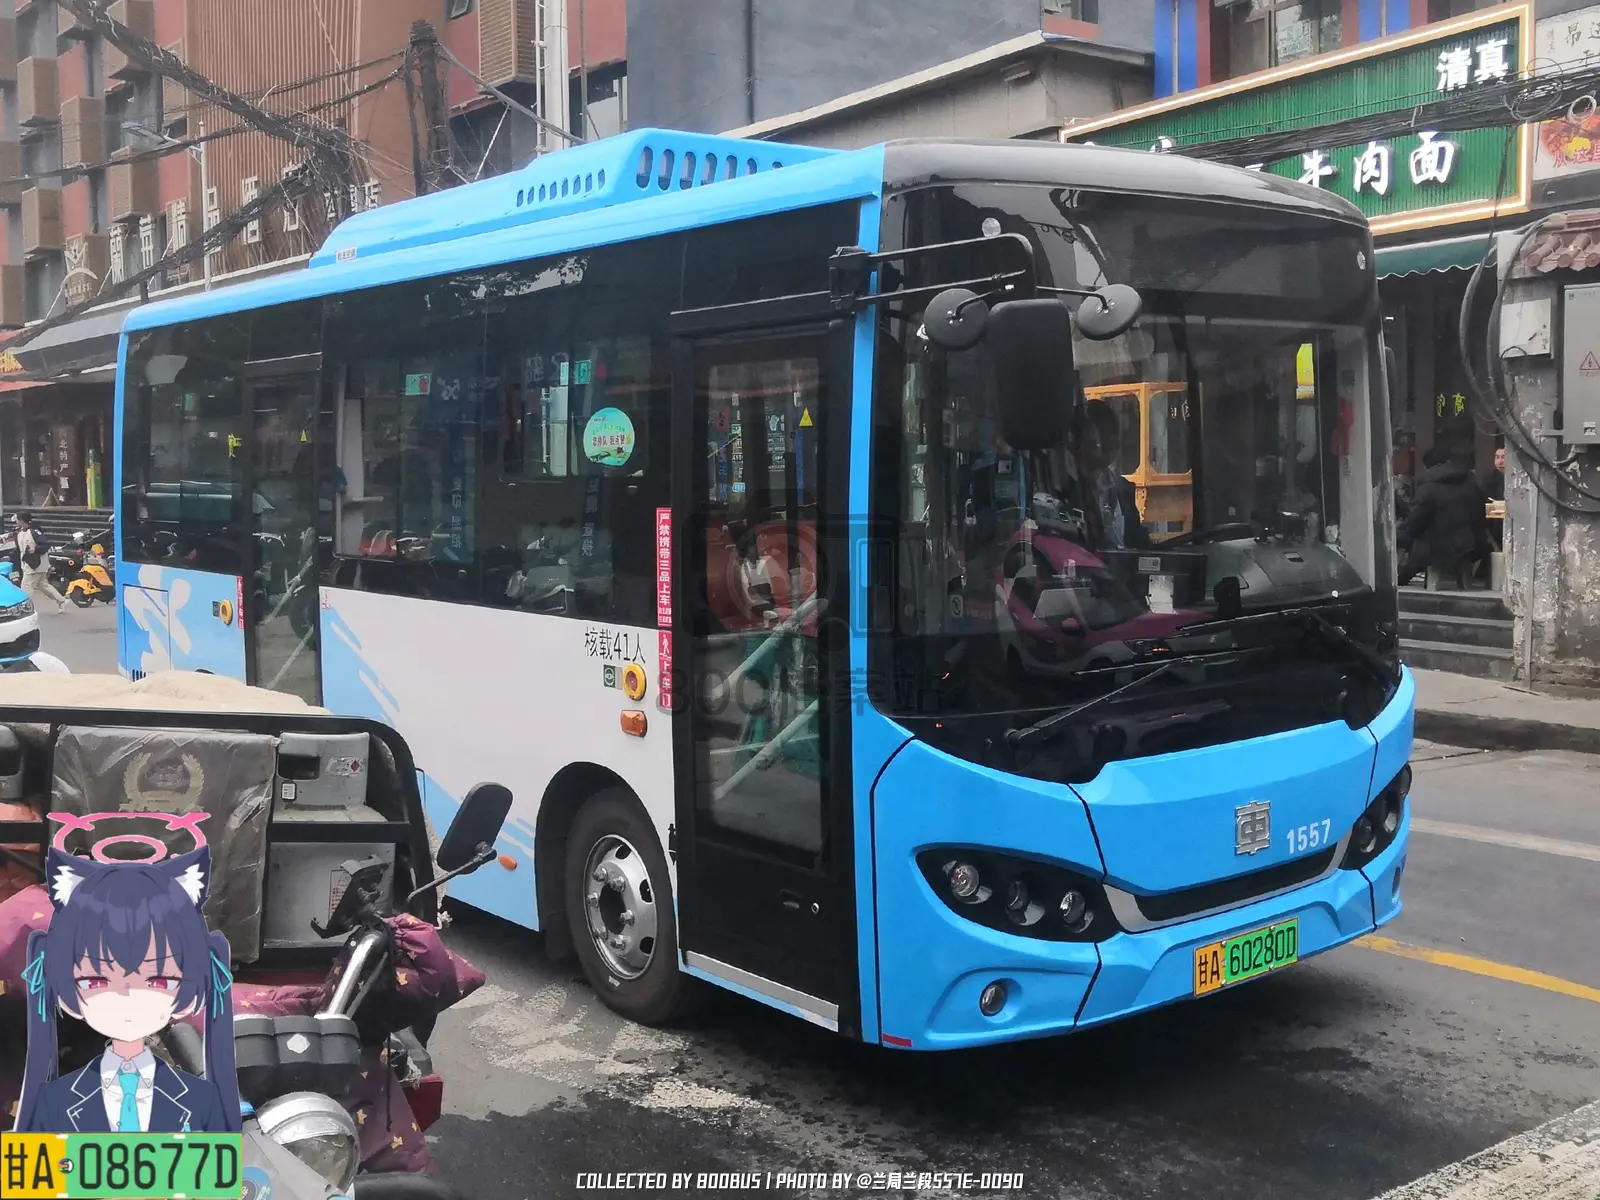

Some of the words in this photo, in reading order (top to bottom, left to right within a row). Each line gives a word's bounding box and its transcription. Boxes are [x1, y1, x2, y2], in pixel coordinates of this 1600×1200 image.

[1436, 38, 1511, 93] 清真
[585, 626, 646, 664] 核载41人
[1287, 818, 1331, 854] 1557
